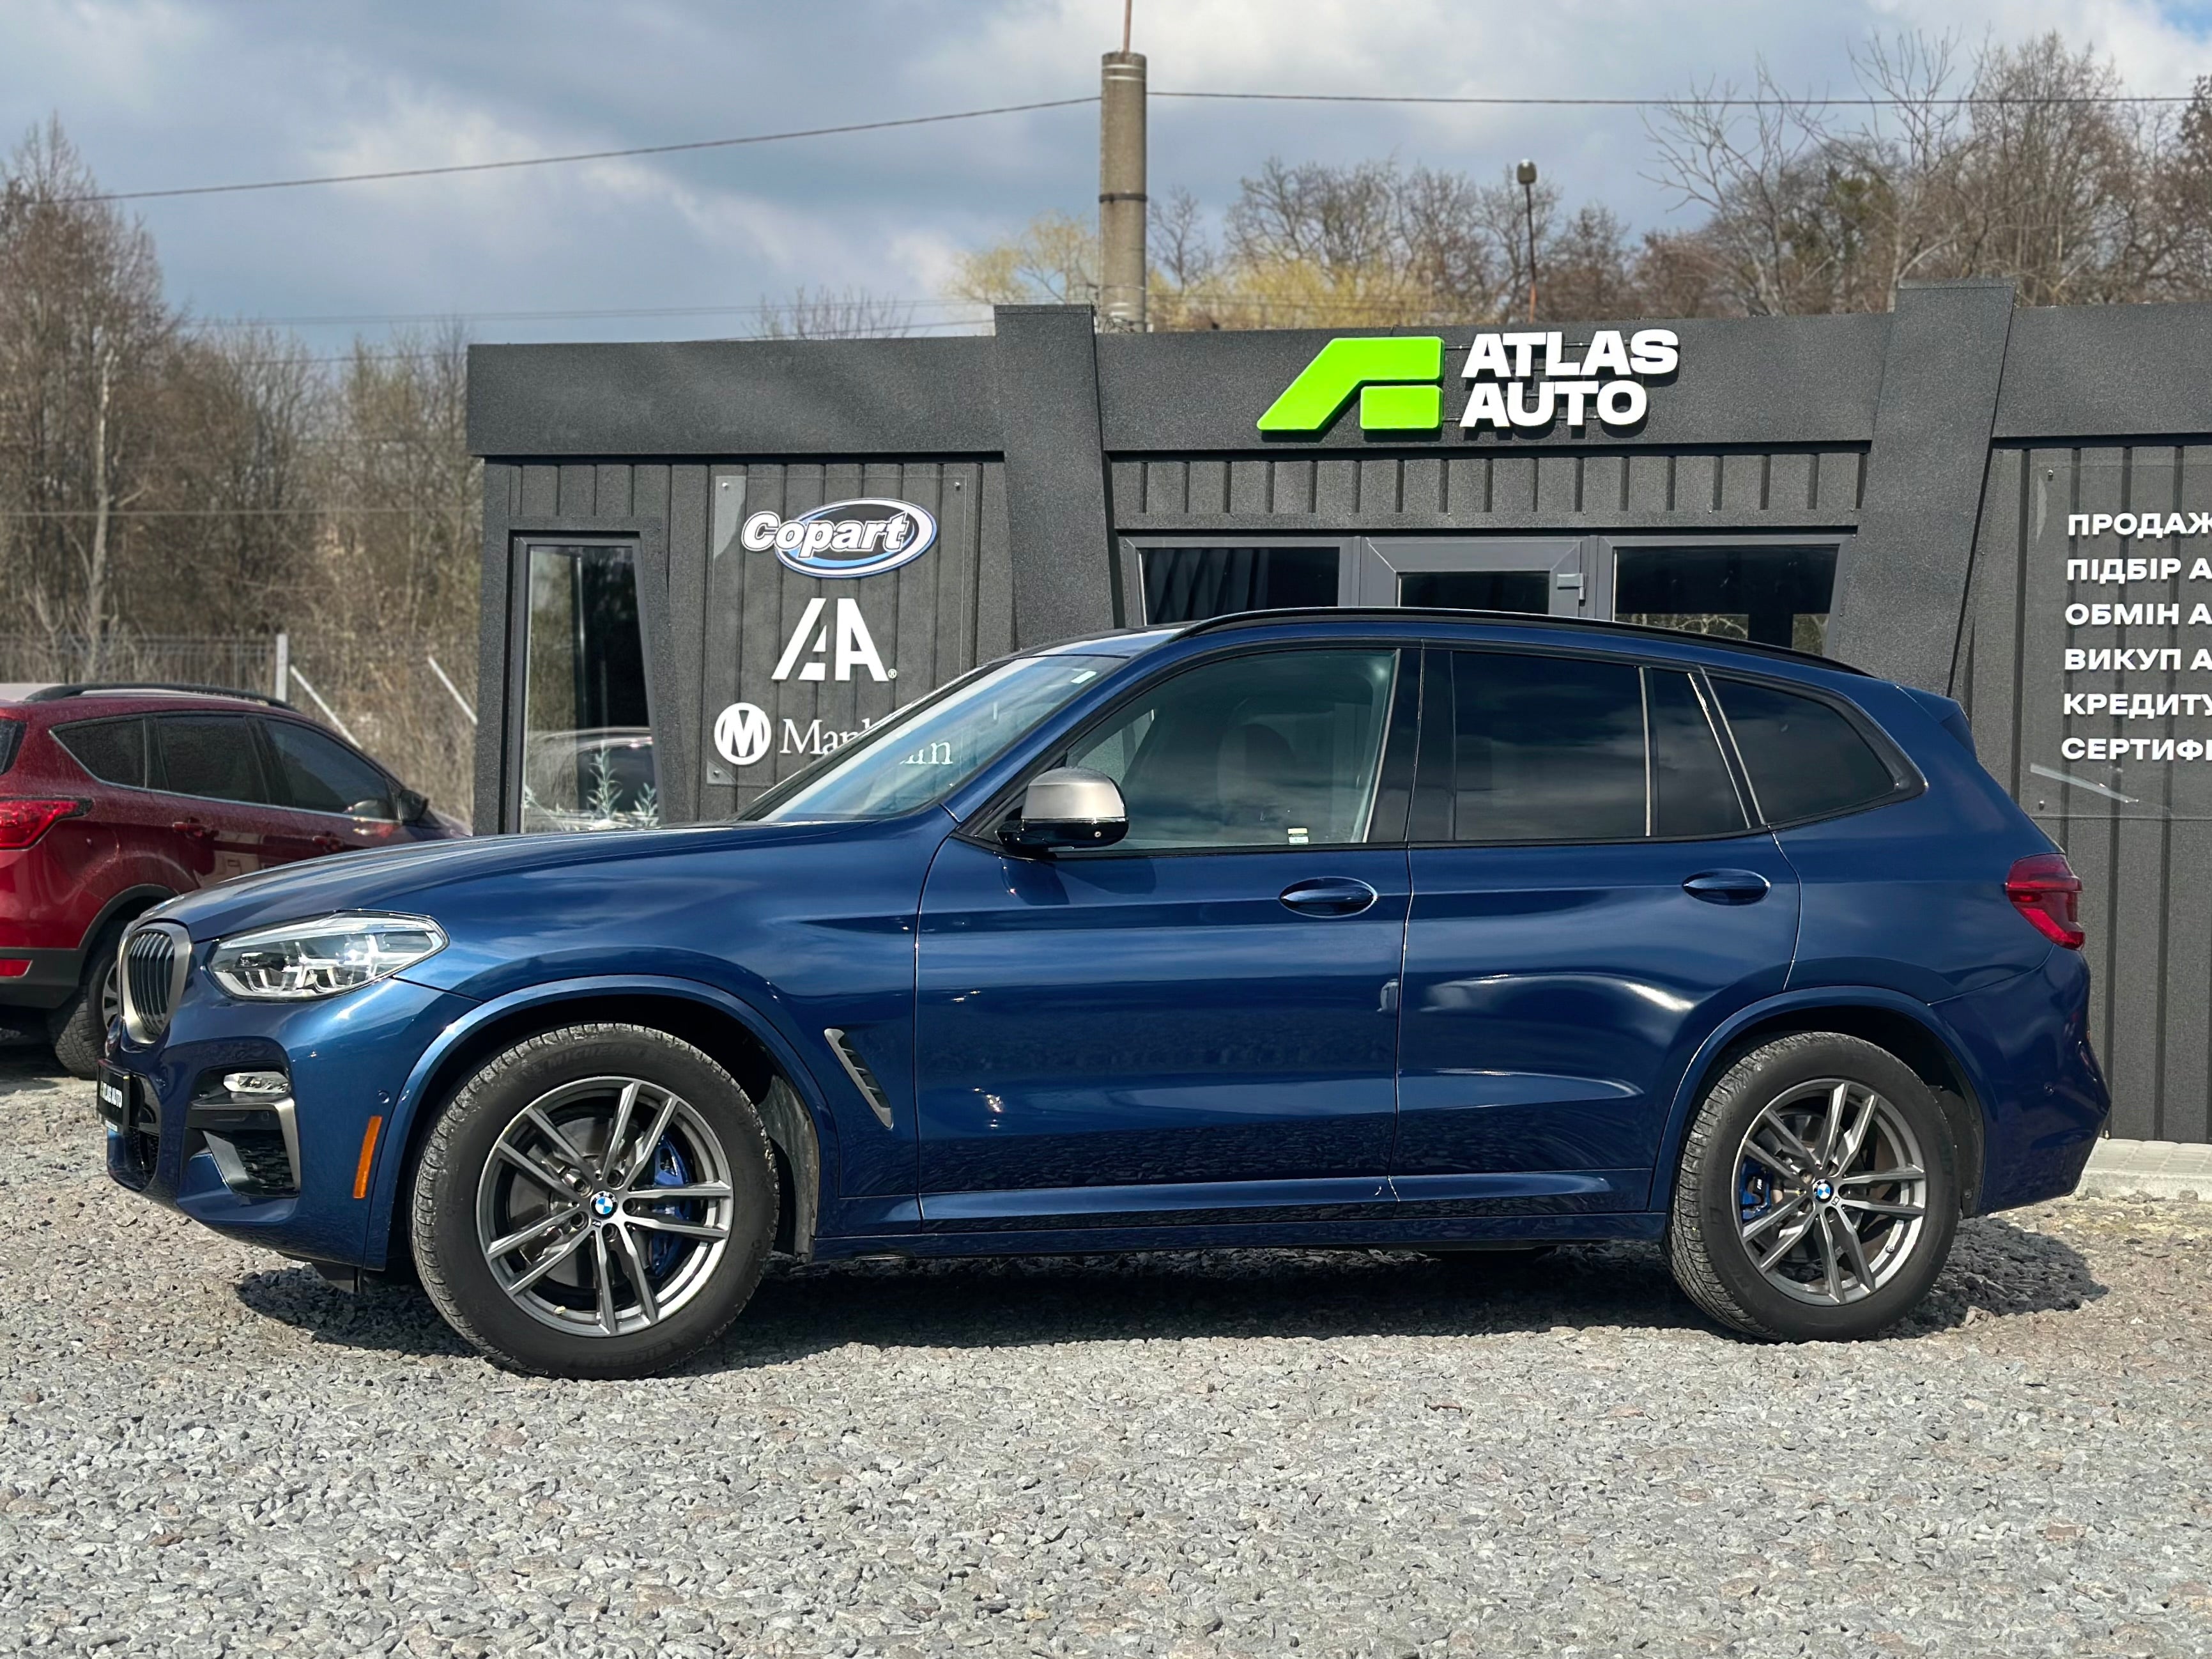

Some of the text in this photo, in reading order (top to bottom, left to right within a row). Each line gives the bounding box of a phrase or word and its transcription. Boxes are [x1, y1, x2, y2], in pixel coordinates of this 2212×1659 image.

[1461, 329, 1678, 378] ATLAS
[1459, 380, 1647, 428] AUTO
[741, 511, 910, 560] Copart
[2067, 557, 2212, 583] ПІДБІР А
[2065, 603, 2212, 625] ОБМІН А
[2064, 648, 2212, 670] ВИКУП А
